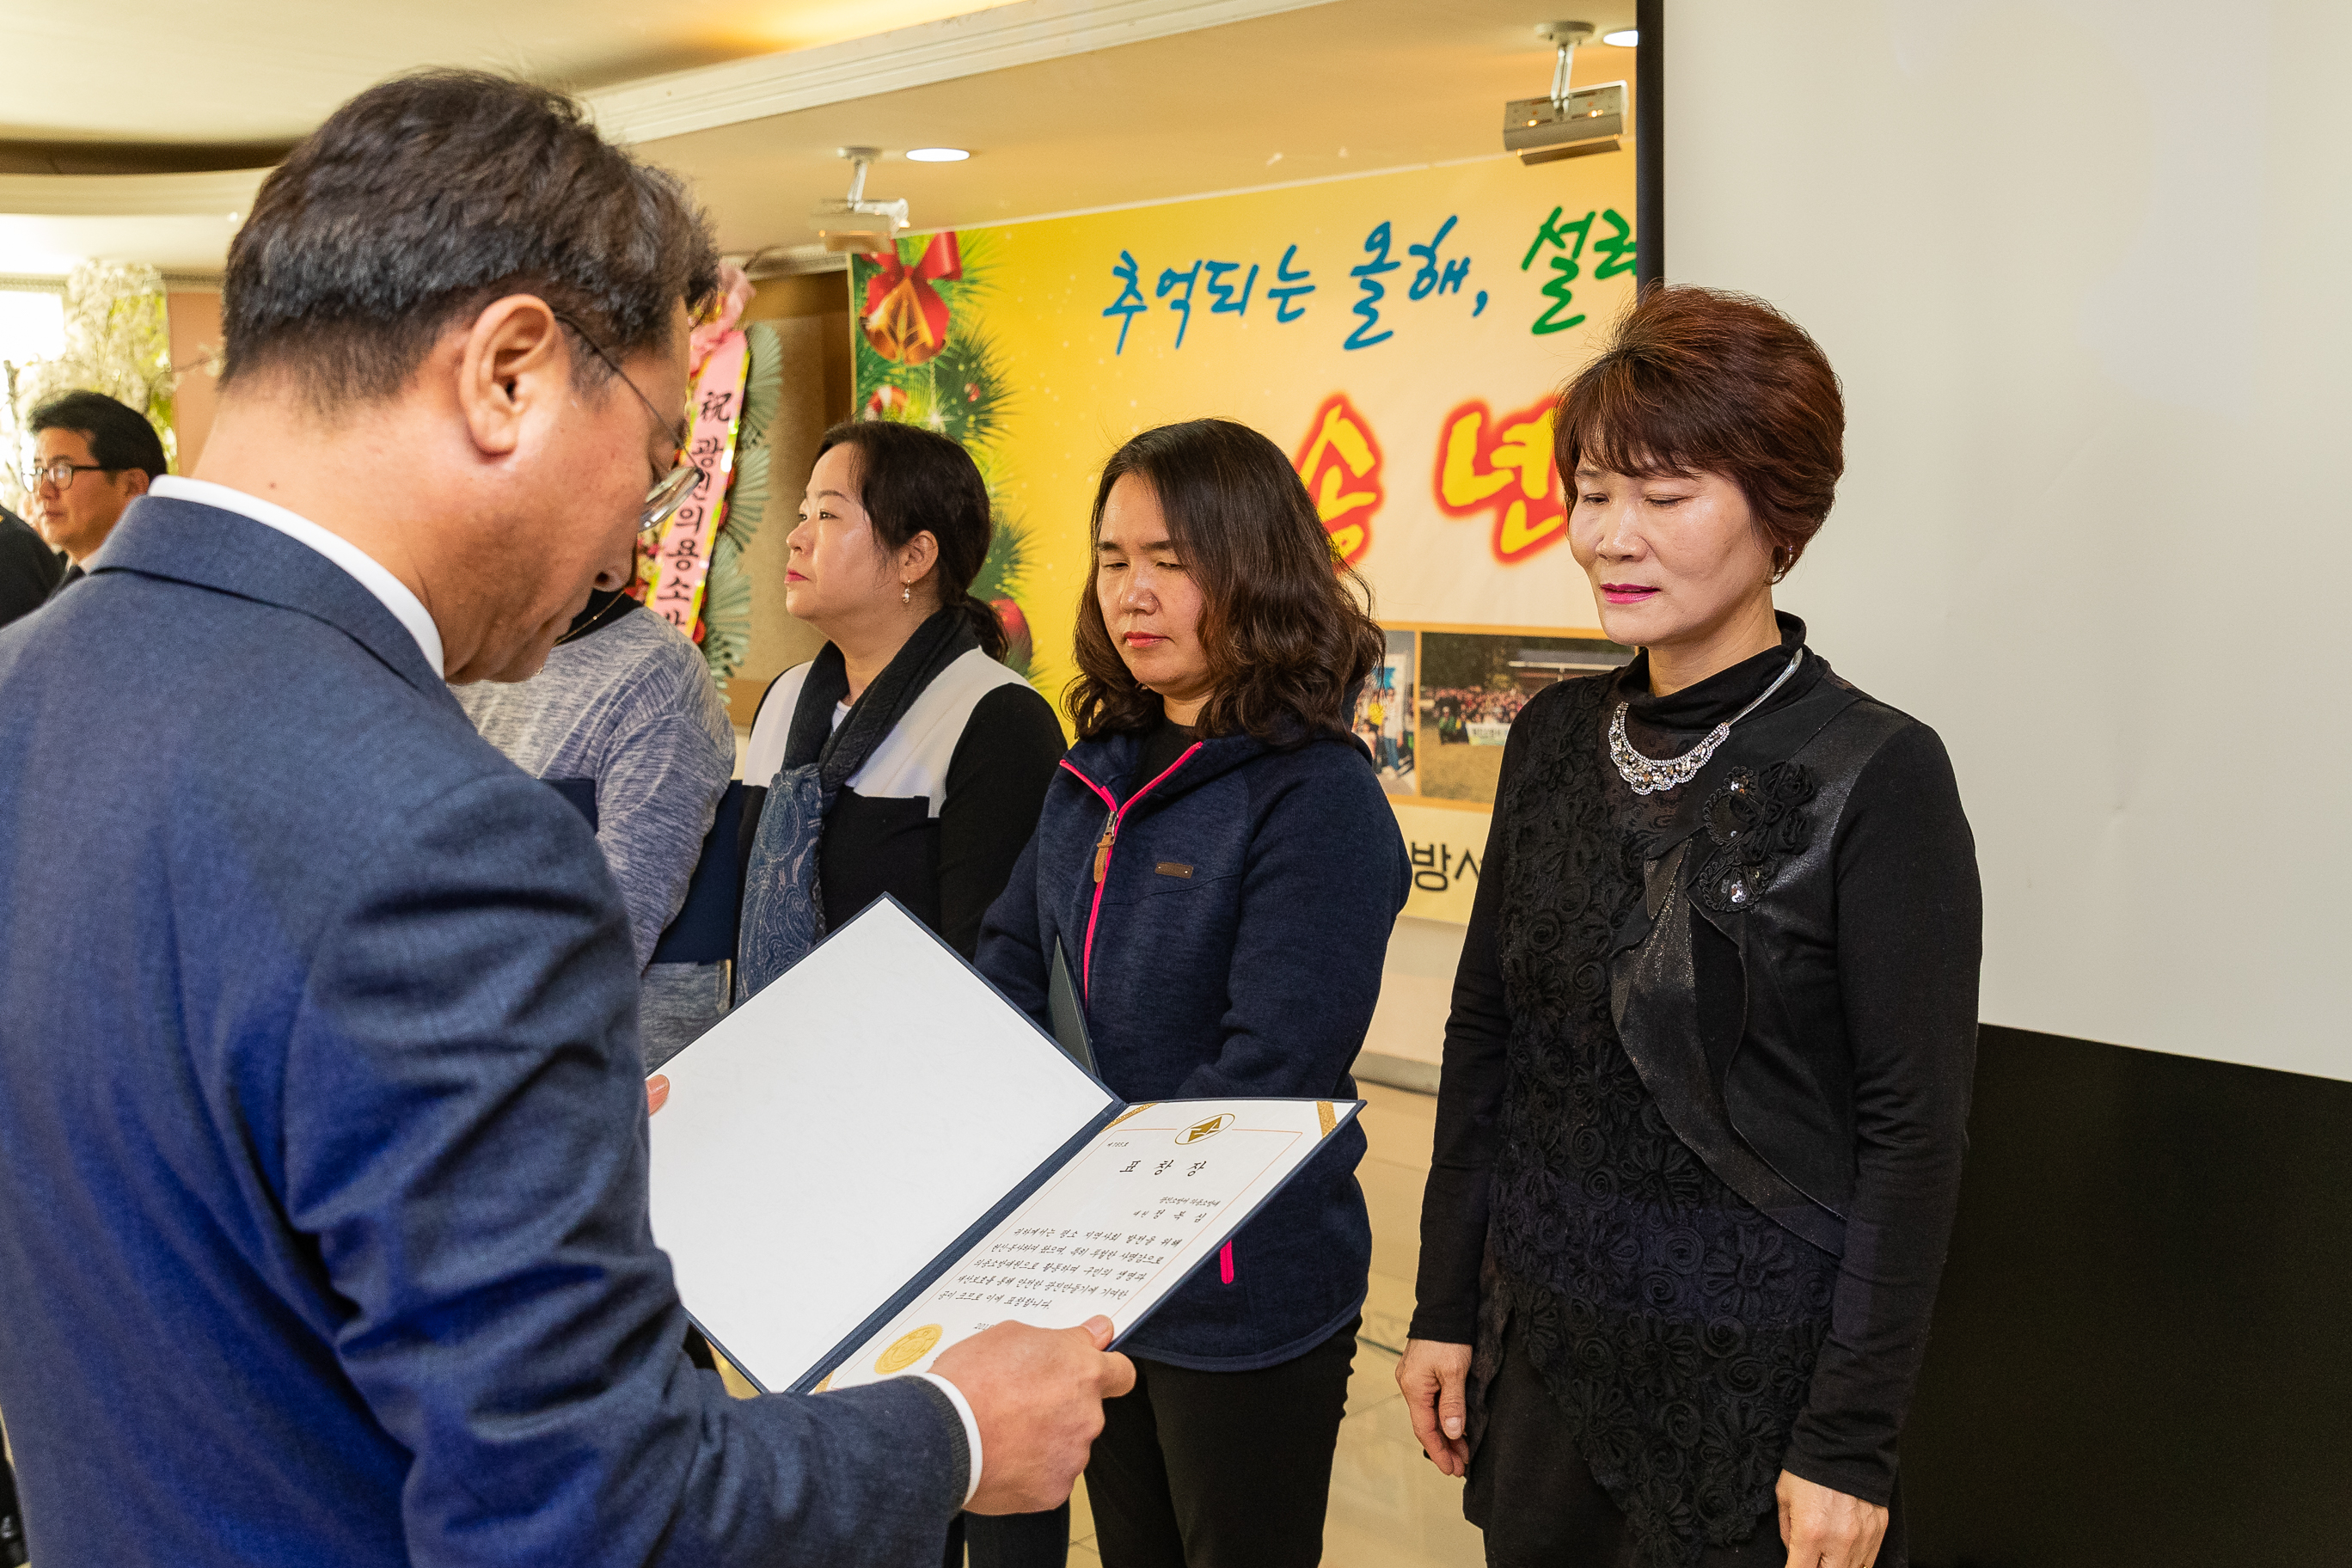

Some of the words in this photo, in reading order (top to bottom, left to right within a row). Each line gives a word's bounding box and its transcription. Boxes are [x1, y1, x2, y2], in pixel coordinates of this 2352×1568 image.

[1102, 243, 1316, 356] 추억되는
[1343, 214, 1488, 351] 올해,
[1083, 1230, 1123, 1242] 지역사회
